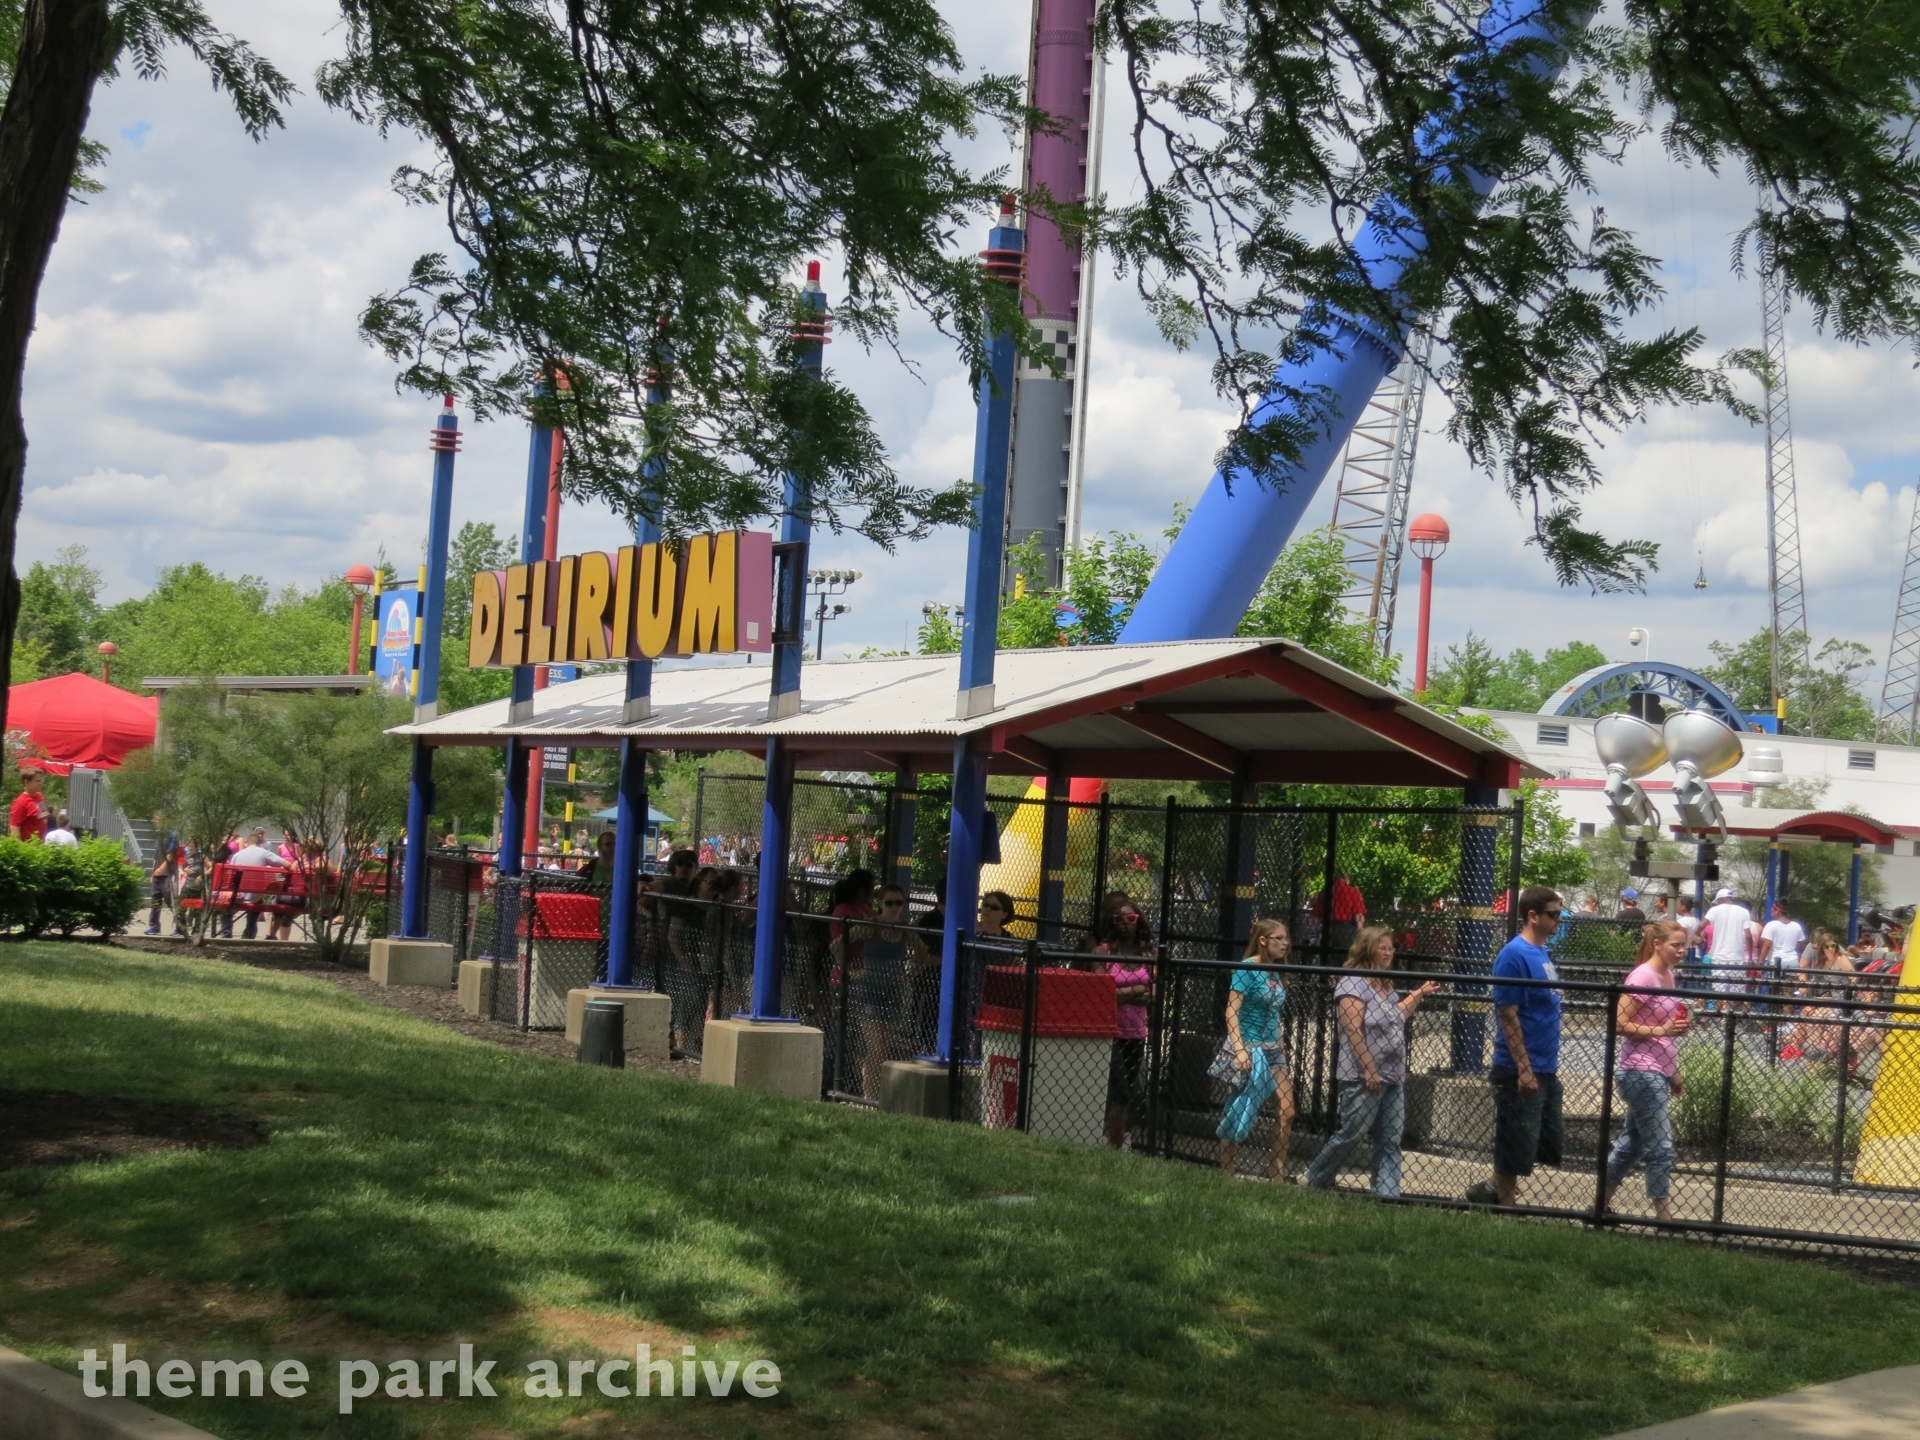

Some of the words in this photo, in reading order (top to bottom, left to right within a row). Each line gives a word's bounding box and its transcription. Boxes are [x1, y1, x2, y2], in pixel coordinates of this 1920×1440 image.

[469, 530, 738, 668] DELIRIUM
[548, 668, 567, 680] ESS...
[553, 754, 568, 762] MORE
[550, 762, 567, 770] RIDES!
